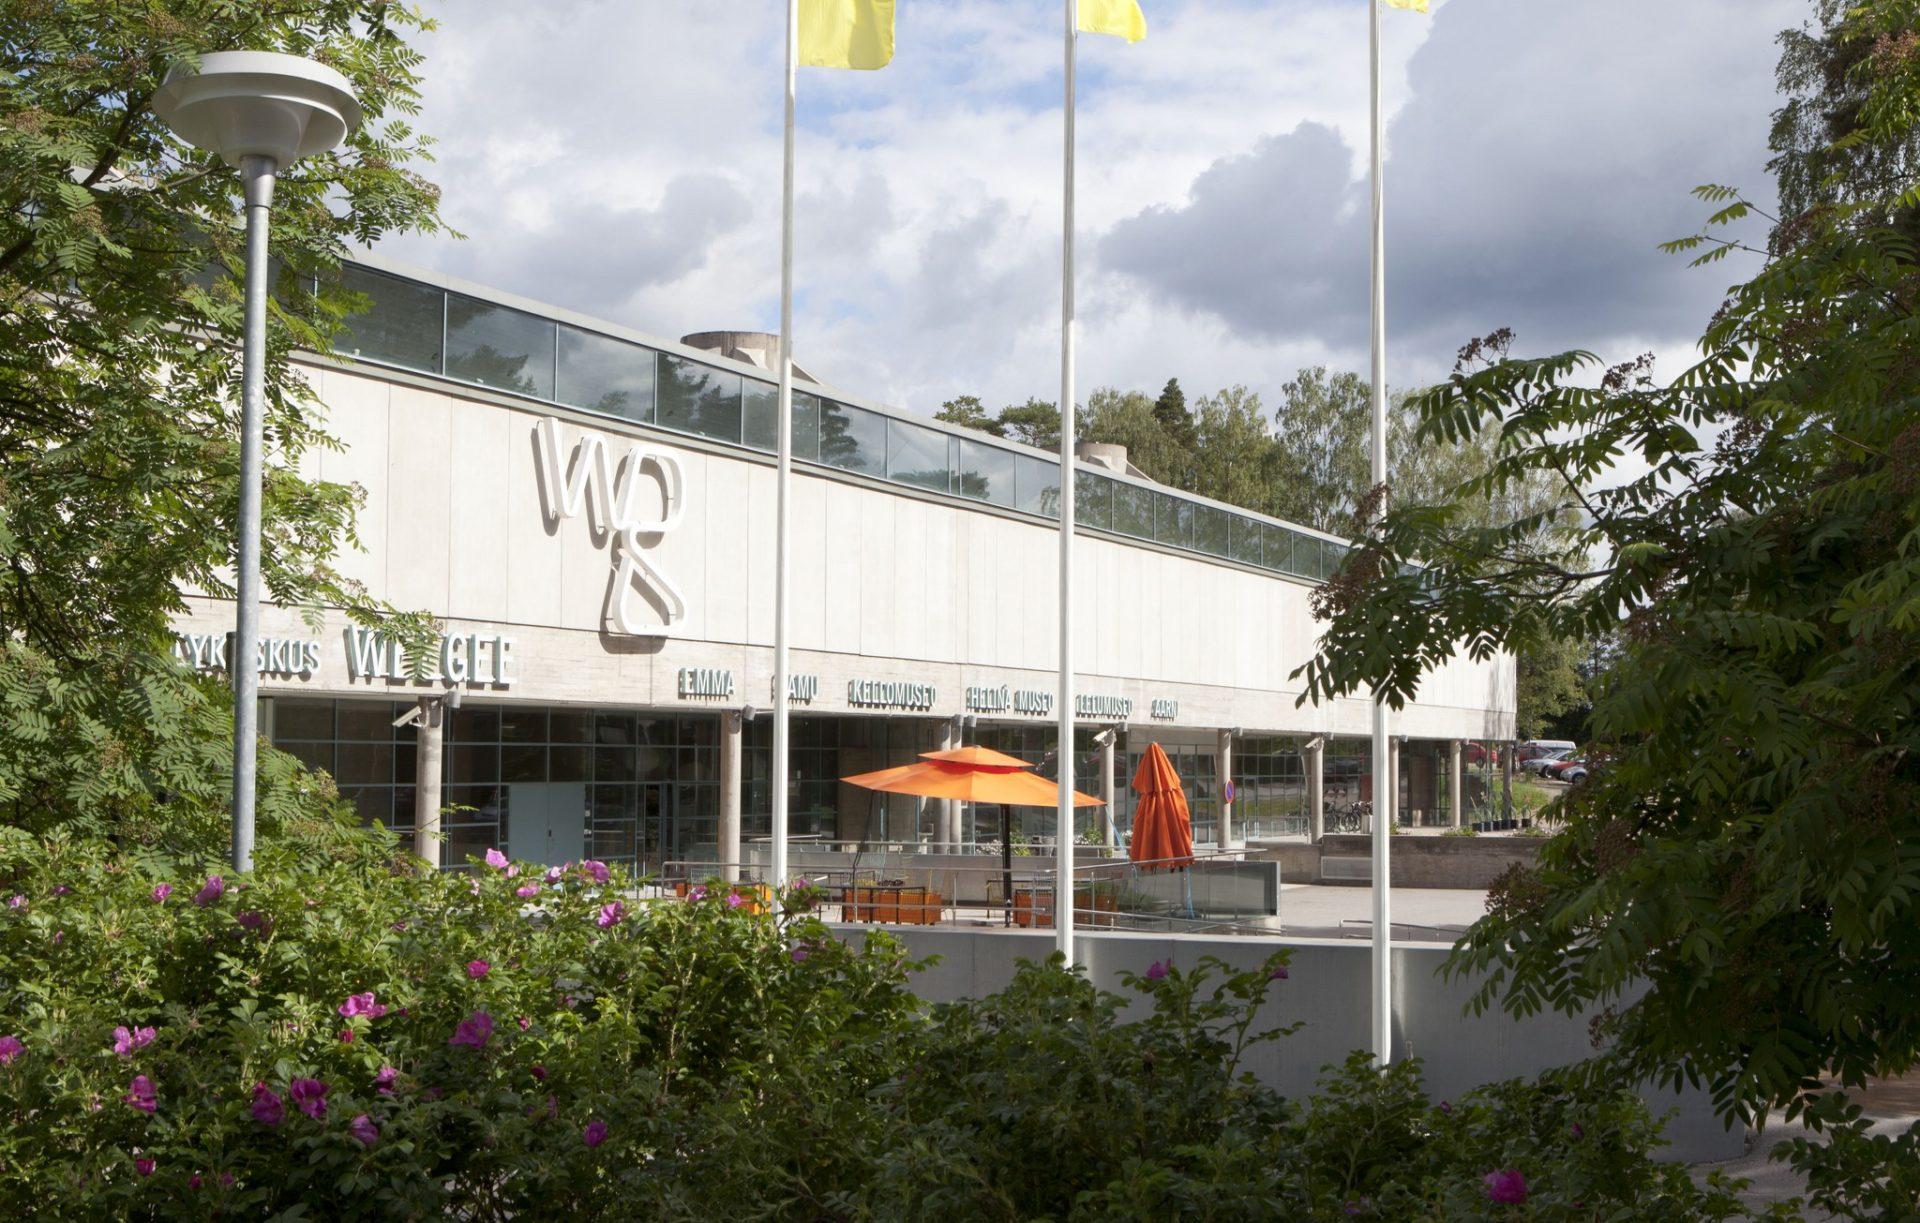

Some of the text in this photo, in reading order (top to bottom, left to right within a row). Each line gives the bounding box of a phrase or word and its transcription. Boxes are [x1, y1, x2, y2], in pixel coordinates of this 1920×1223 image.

[679, 667, 736, 696] EMMA
[782, 672, 821, 699] AMU
[850, 678, 938, 707] KELLOMUSEO
[1017, 690, 1054, 712] MUSEO
